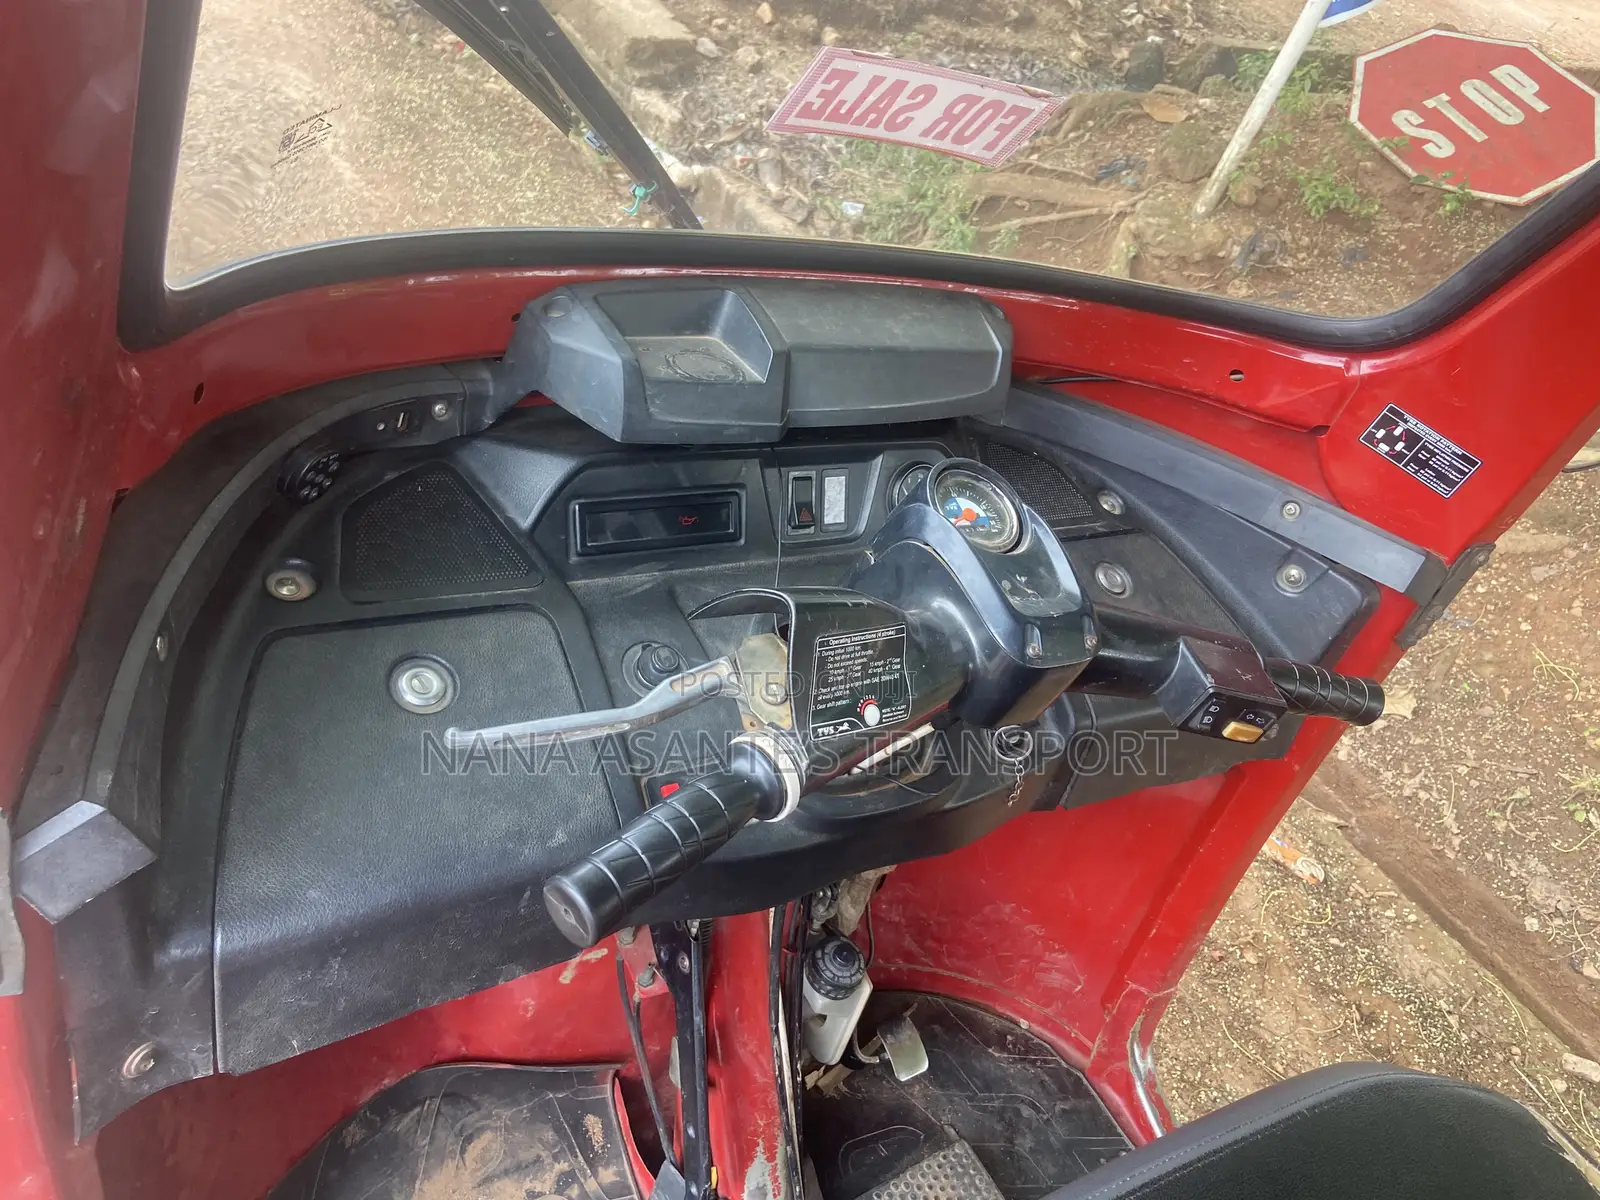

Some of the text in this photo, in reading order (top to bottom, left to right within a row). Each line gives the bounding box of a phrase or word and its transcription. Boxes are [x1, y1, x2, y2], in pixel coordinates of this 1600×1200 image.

[1391, 64, 1550, 158] STOP
[829, 637, 850, 646] Operating
[852, 633, 876, 642] Instructions
[817, 726, 834, 737] TVS
